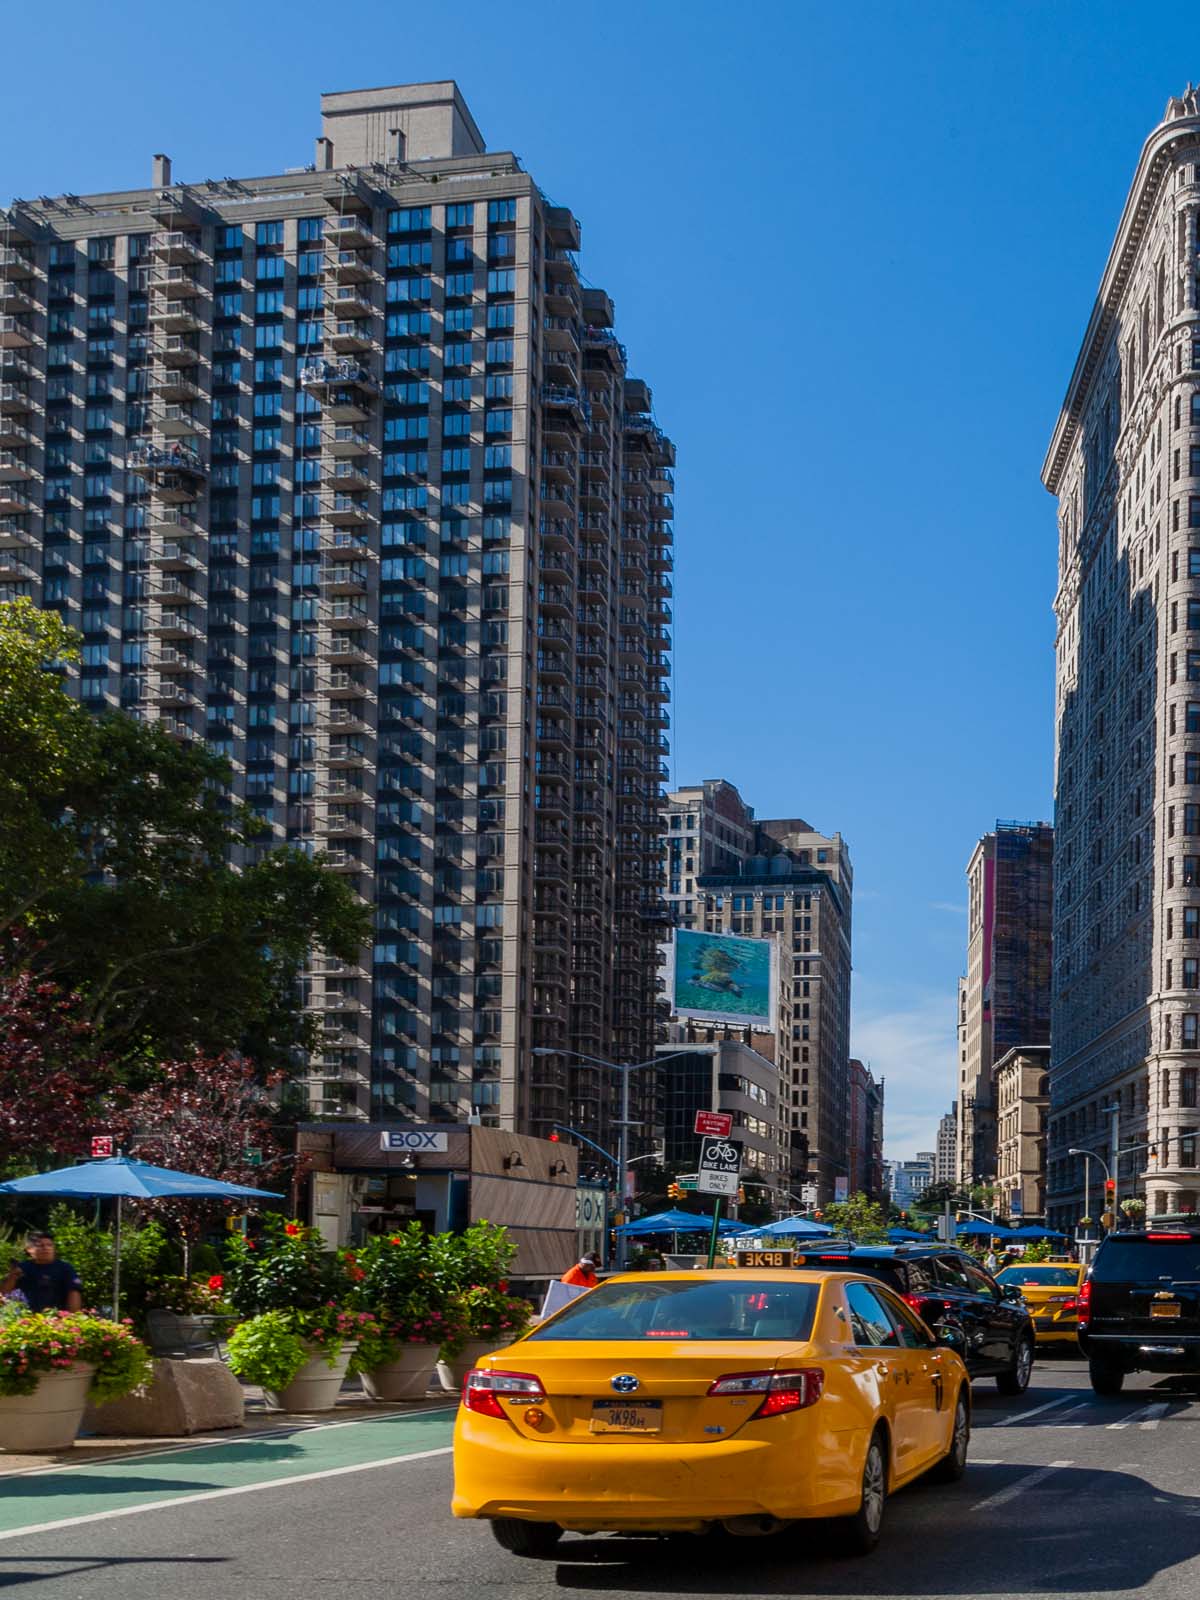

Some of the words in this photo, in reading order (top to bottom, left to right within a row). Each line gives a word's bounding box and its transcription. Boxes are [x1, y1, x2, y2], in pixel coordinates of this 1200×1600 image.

[389, 1132, 438, 1148] BOX
[703, 1161, 718, 1169] BIKE
[720, 1162, 738, 1171] LANE
[709, 1173, 729, 1182] BIKES
[709, 1182, 727, 1190] ONLY
[745, 1253, 783, 1266] 3K98
